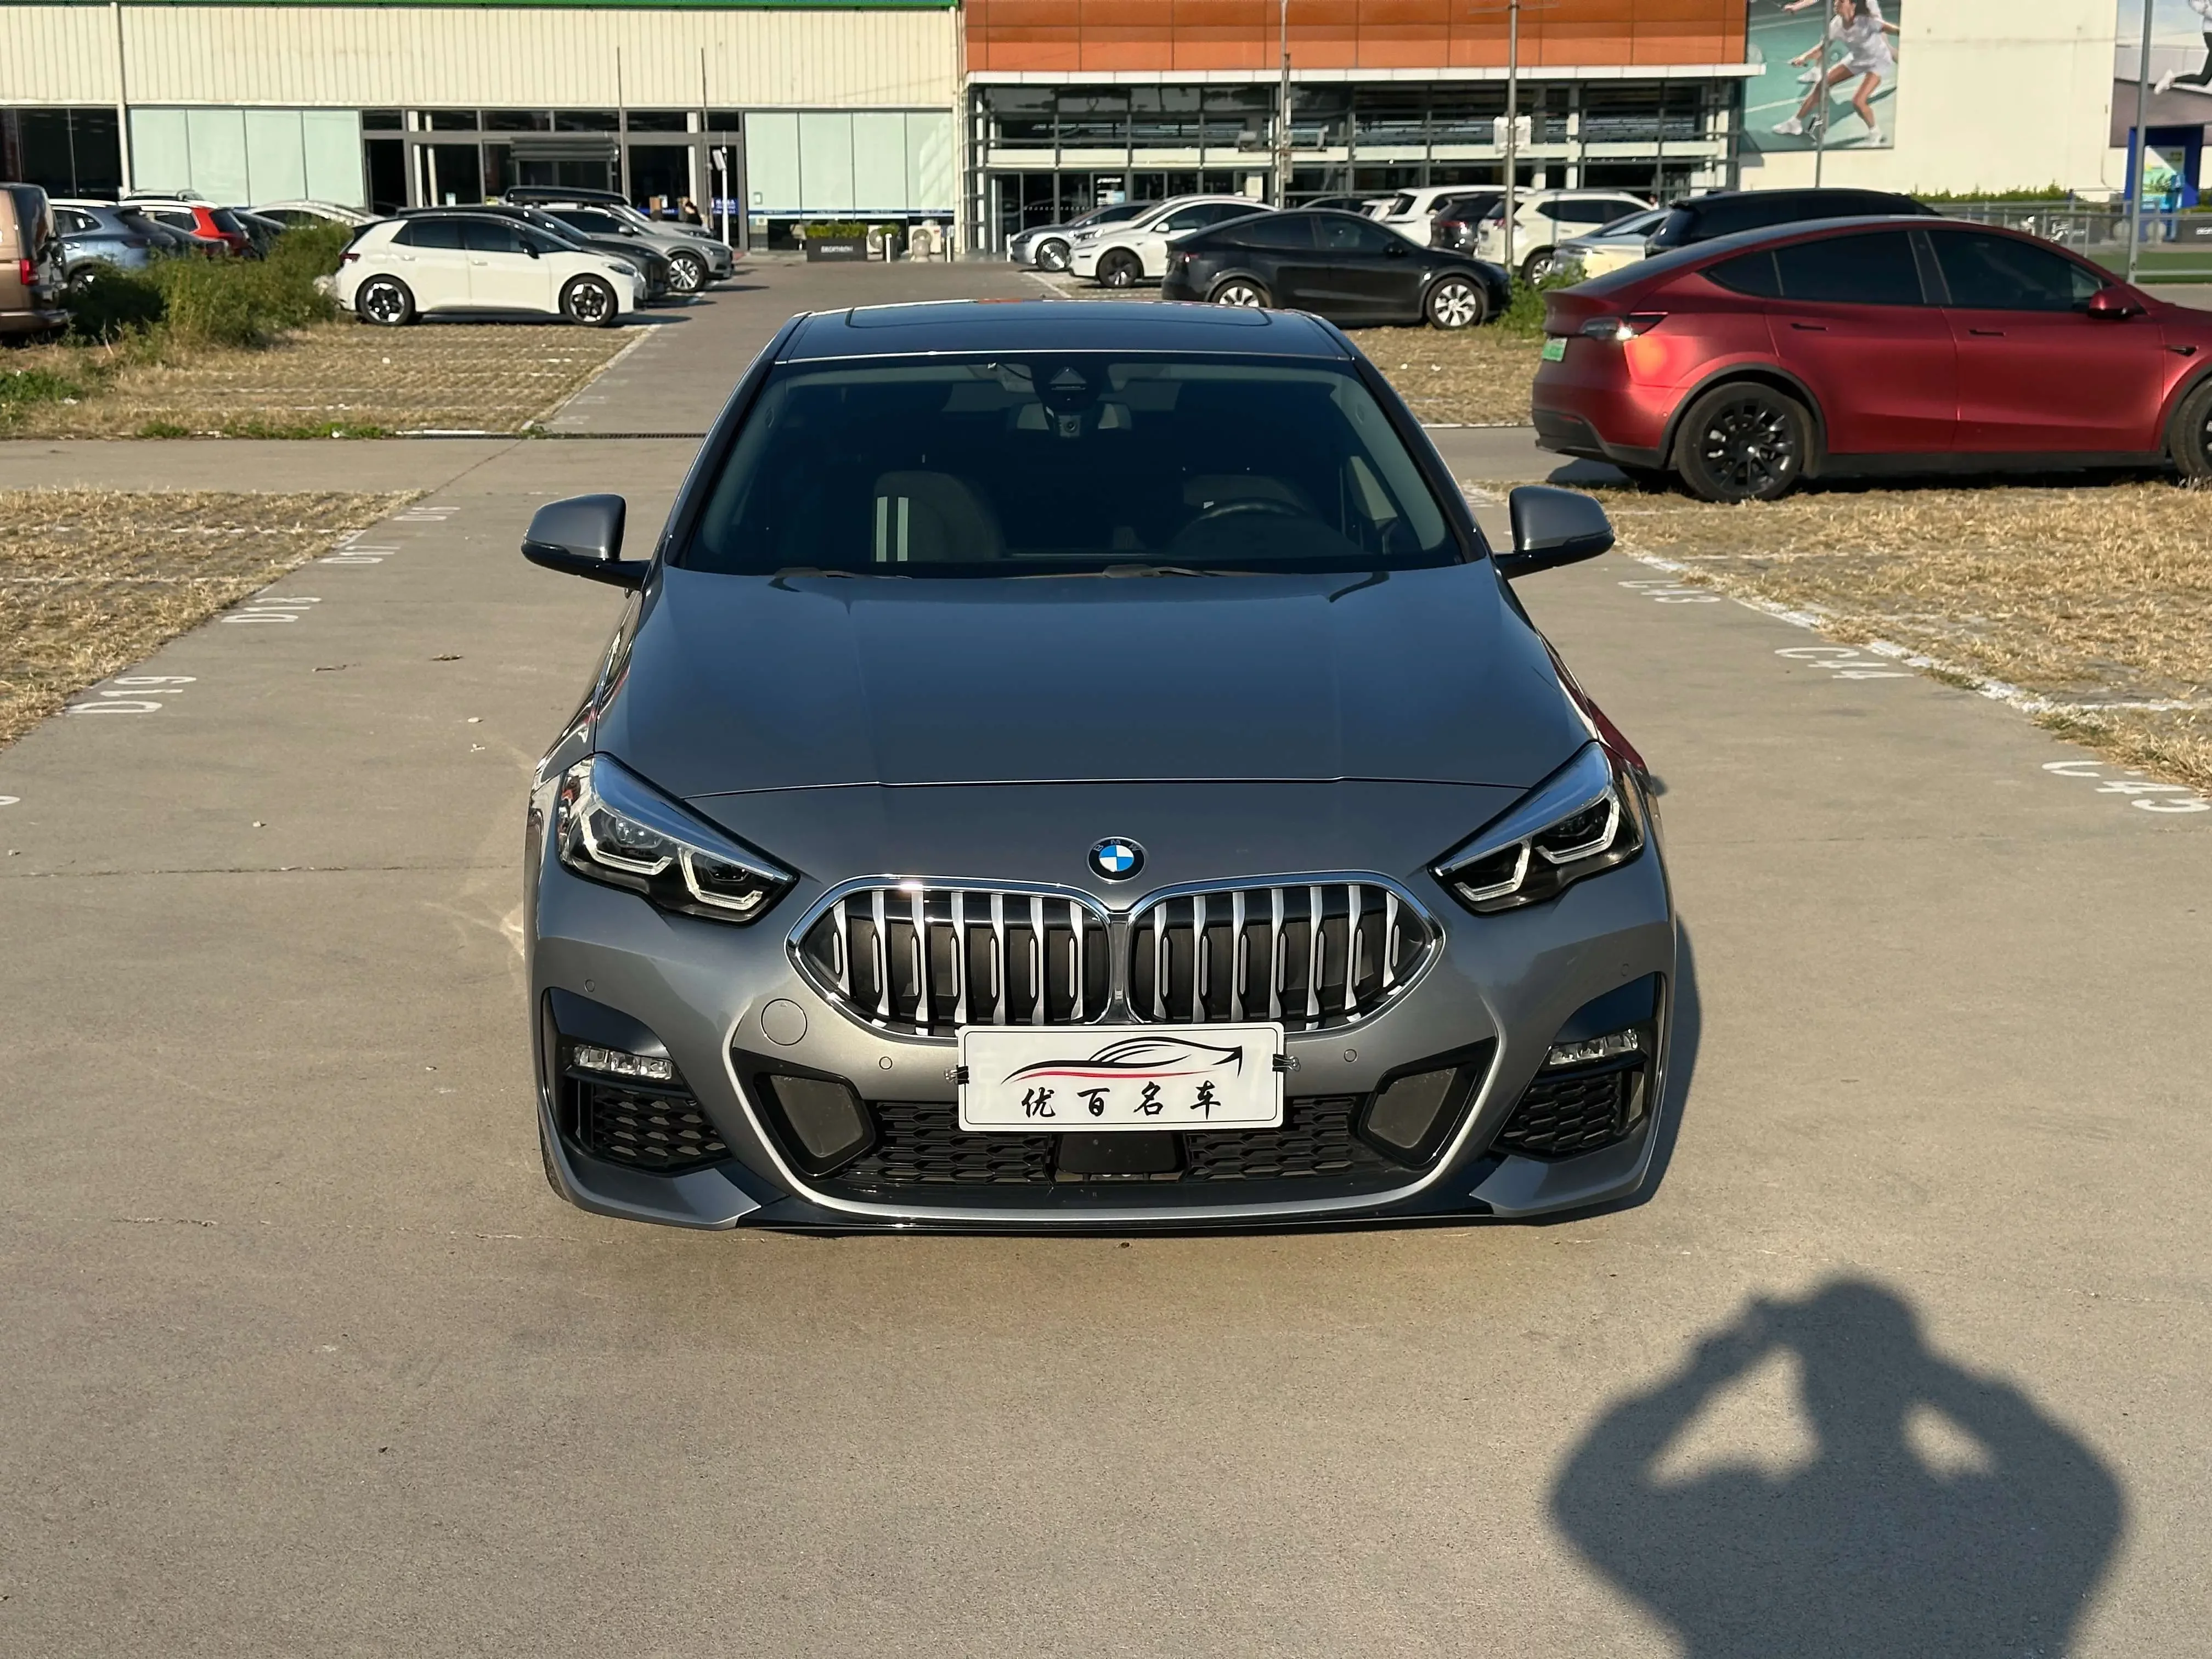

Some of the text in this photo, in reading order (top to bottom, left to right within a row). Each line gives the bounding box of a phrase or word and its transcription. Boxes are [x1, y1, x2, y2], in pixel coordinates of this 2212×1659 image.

[1617, 579, 1722, 603] C43
[1774, 646, 1915, 680] C44
[65, 675, 198, 713] D19
[1092, 839, 1142, 852] BMW
[1021, 1080, 1221, 1120] 优百名车
